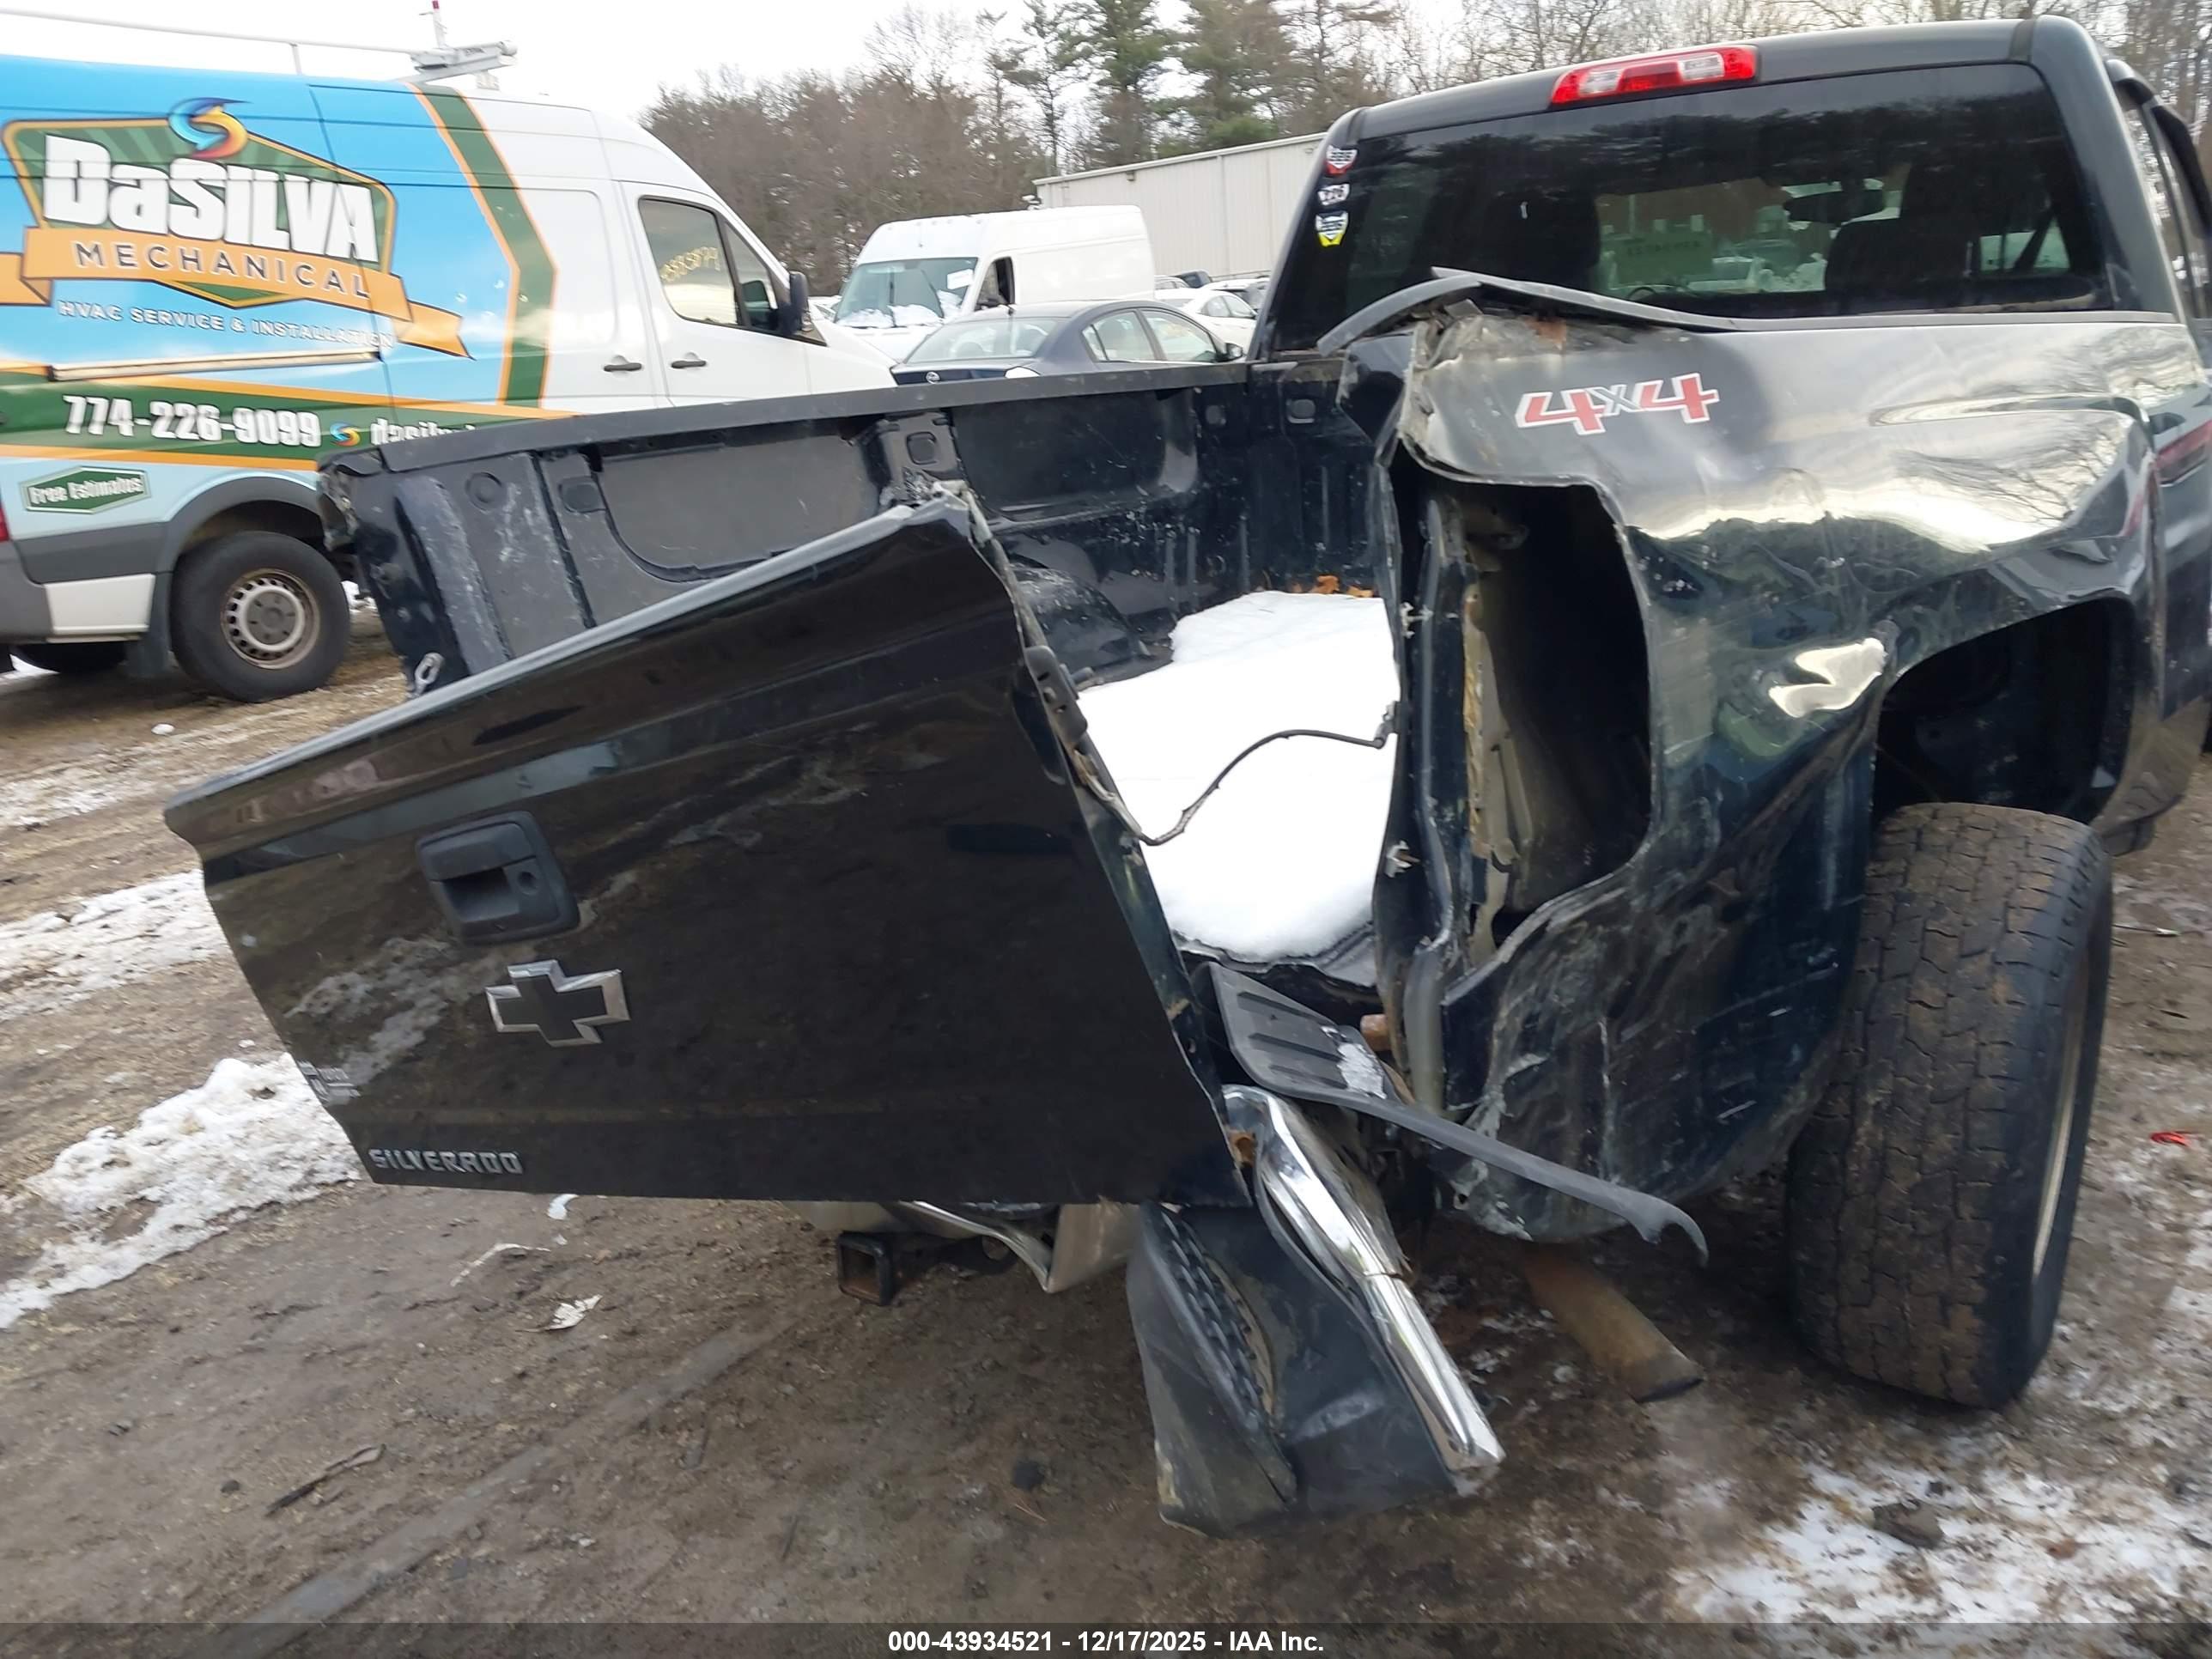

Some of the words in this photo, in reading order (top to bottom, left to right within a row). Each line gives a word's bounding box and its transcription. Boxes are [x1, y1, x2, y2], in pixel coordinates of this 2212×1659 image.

[74, 240, 371, 300] MECHANICAL
[58, 301, 124, 321] HVAC
[130, 307, 225, 331] SERVICE
[230, 316, 247, 333] &
[63, 394, 323, 447] 774-226-9099
[27, 486, 69, 505] Free
[368, 1148, 524, 1175] SILVERADO
